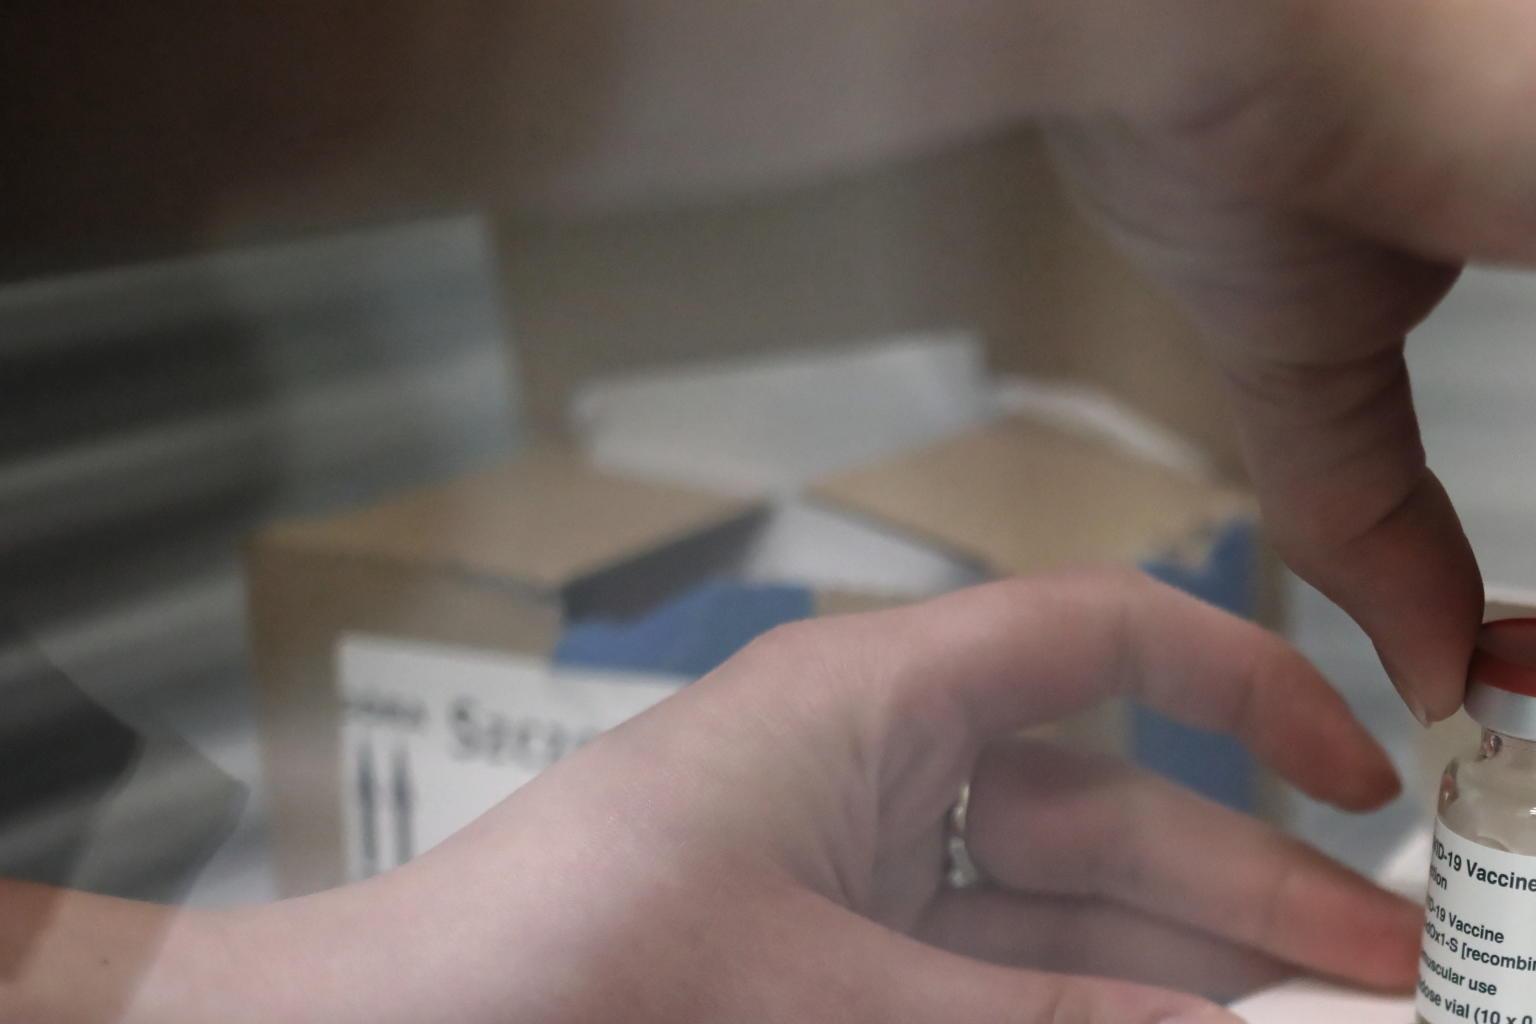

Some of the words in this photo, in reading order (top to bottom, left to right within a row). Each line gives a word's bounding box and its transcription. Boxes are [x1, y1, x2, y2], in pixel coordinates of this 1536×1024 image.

[1449, 912, 1504, 944] Vaccine
[1468, 978, 1497, 996] use
[1445, 998, 1470, 1019] vial
